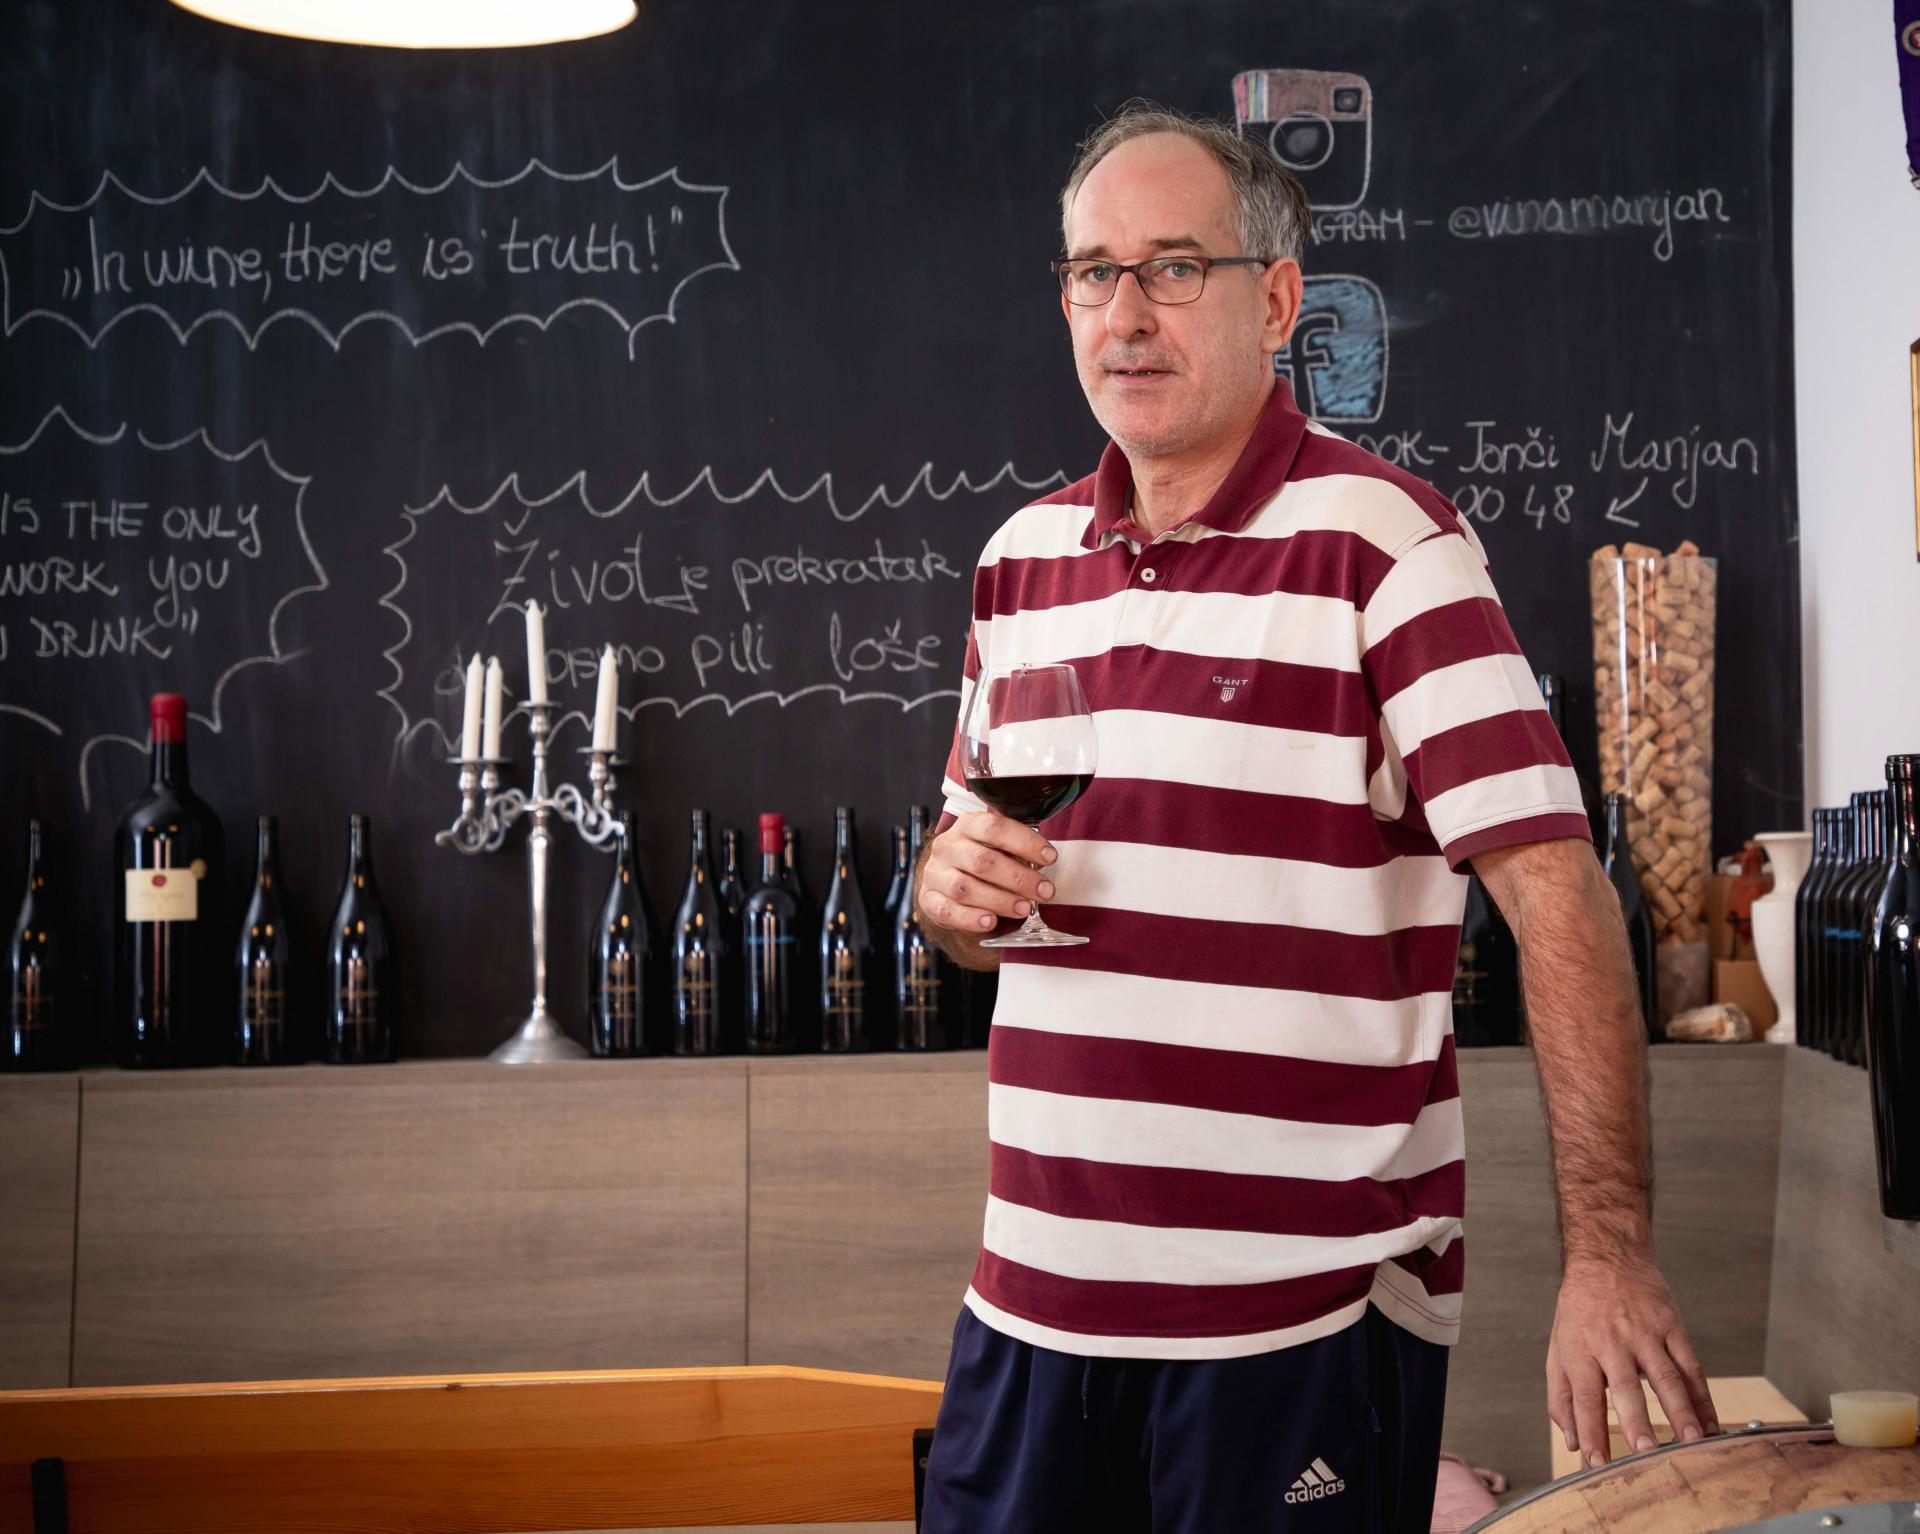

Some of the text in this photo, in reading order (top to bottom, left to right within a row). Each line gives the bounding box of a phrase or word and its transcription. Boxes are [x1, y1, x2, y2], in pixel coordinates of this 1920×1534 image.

[144, 236, 272, 303] wine,
[280, 220, 397, 284] there
[1458, 420, 1561, 474] Jonči
[0, 492, 40, 535] IS
[62, 499, 149, 540] THE
[1523, 484, 1574, 531] 48
[732, 537, 962, 613] prekratak
[691, 621, 774, 689] pili
[829, 610, 942, 682] loše
[1212, 676, 1249, 686] GANT
[1284, 1479, 1346, 1504] adidas
